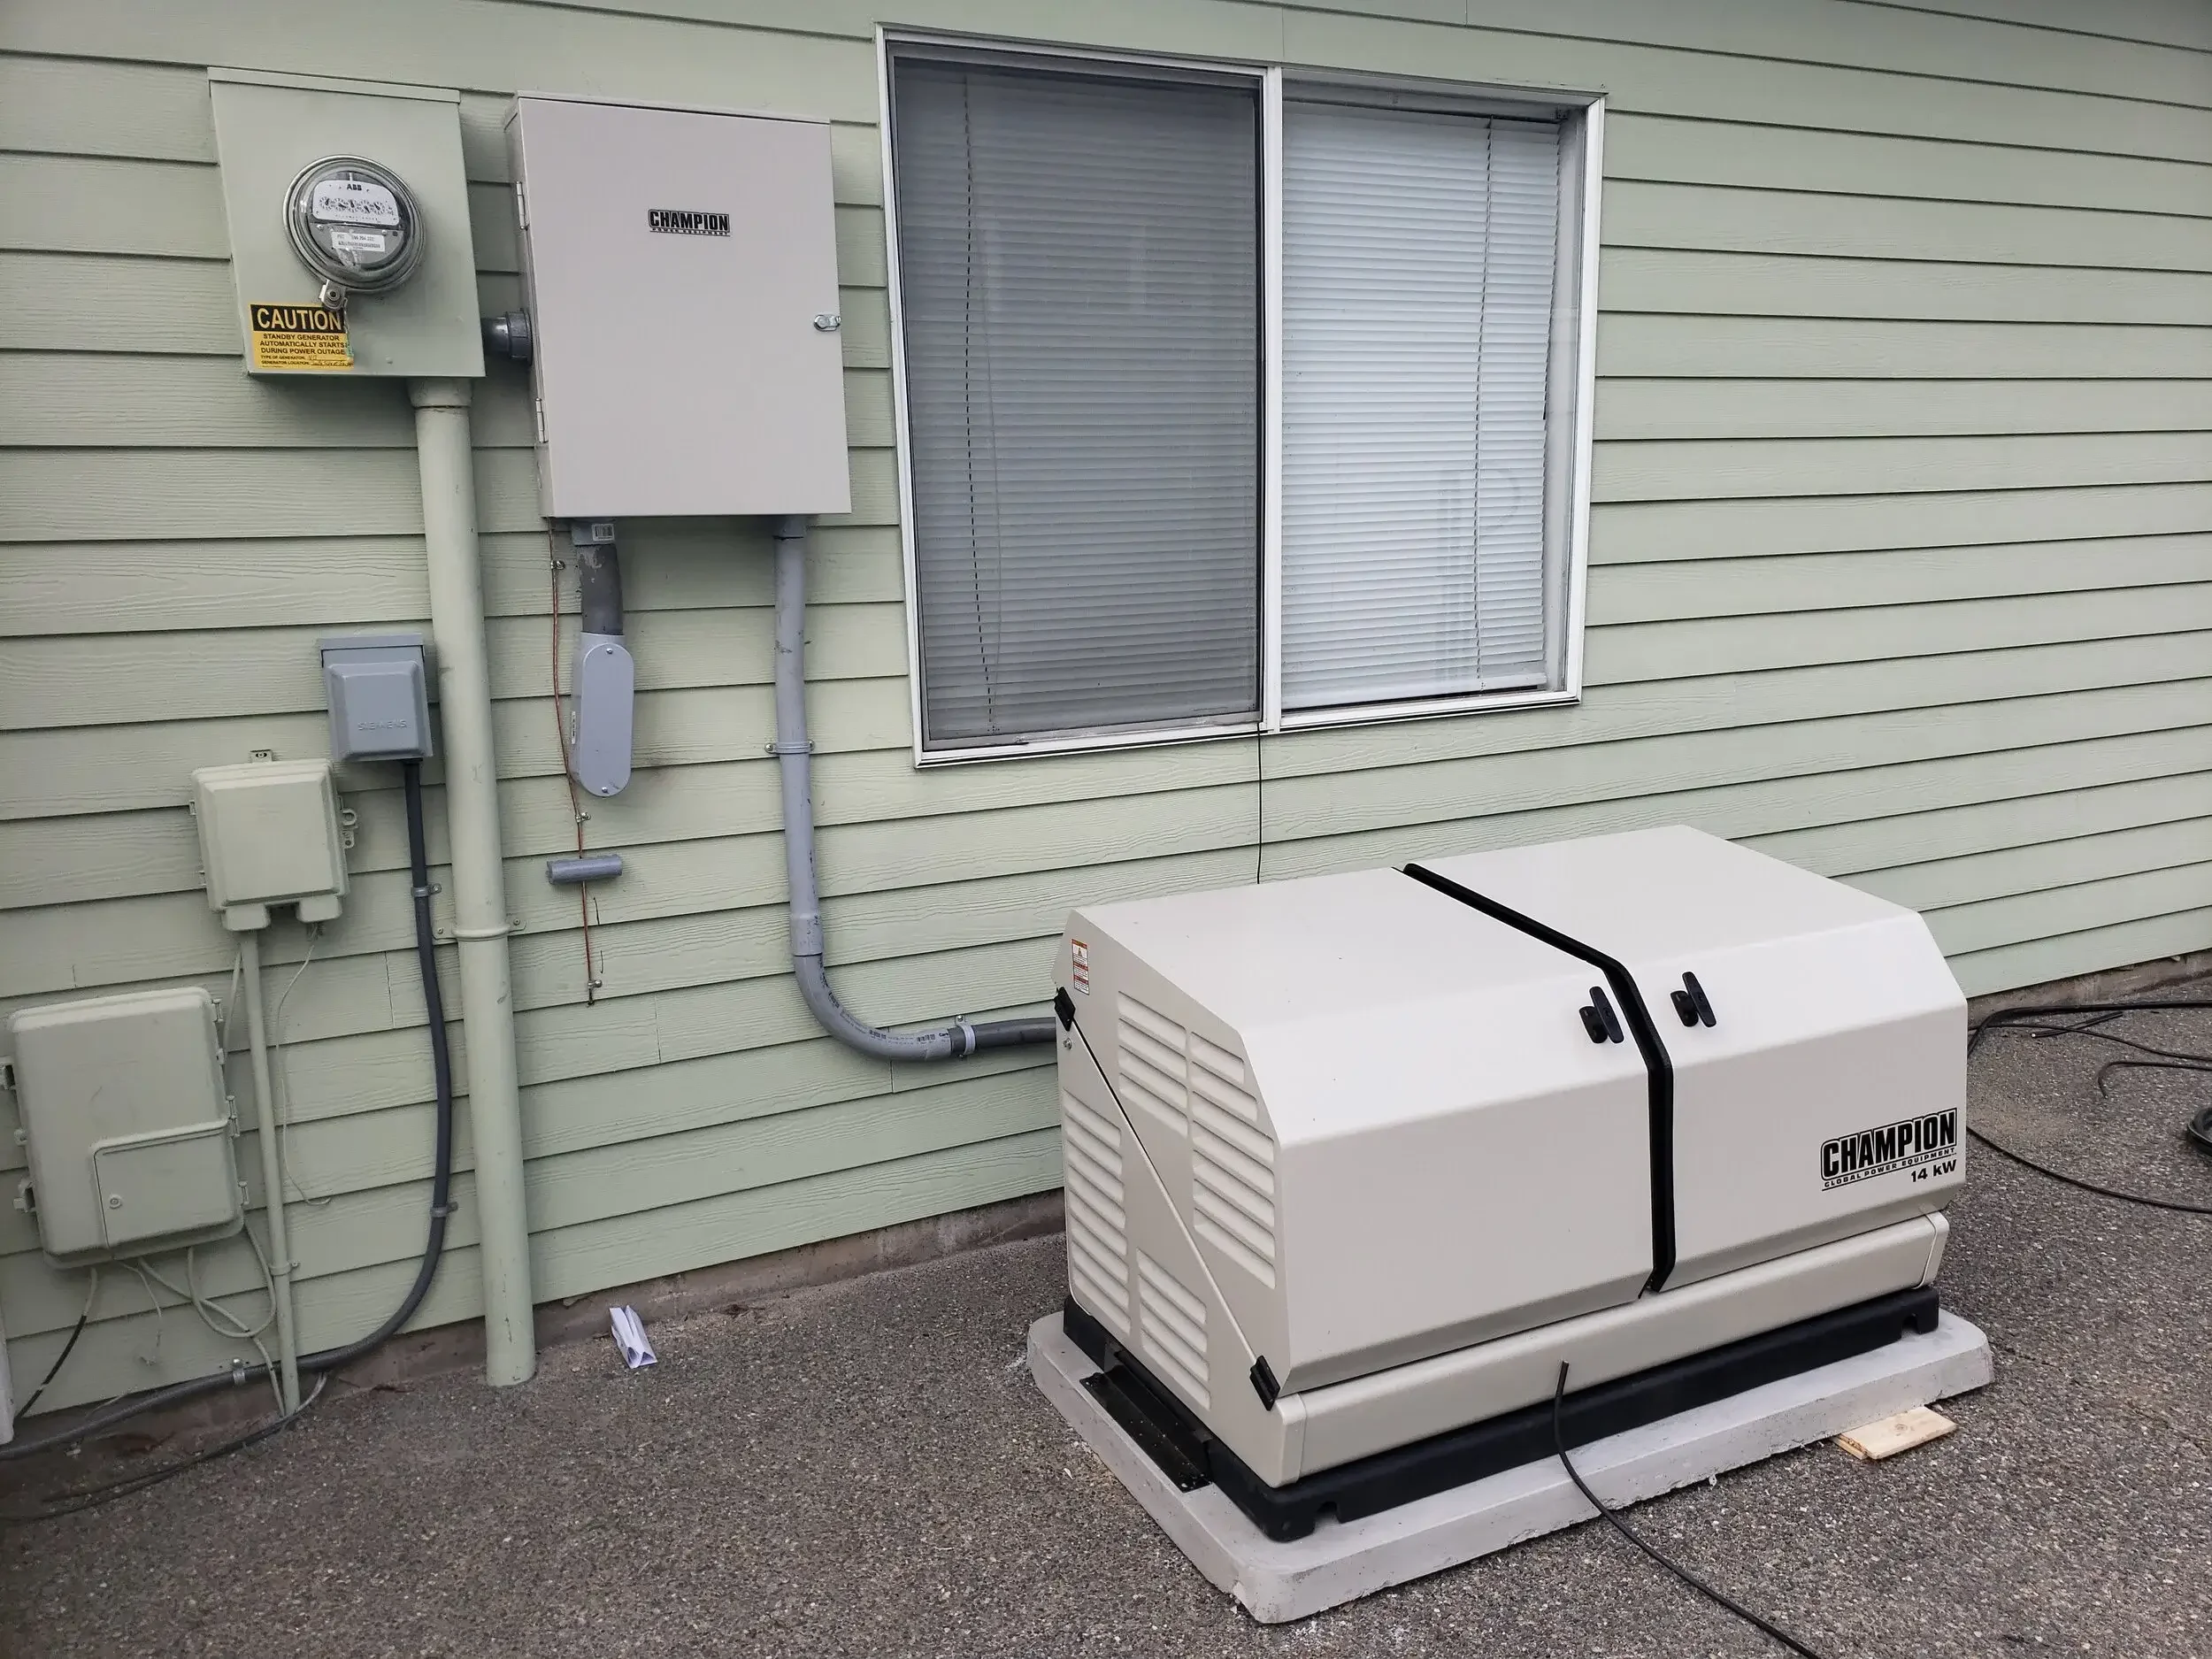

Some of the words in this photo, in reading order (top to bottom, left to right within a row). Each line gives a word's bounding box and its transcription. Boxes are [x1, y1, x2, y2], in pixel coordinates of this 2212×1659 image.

[649, 211, 728, 231] CHAMPION
[257, 308, 342, 331] CAUTION
[1823, 1110, 1955, 1178] CHAMPION
[1824, 1173, 1862, 1187] GLOBAL
[1864, 1164, 1897, 1177] POWER
[1901, 1148, 1955, 1166] EQUIPMENT
[1911, 1168, 1928, 1182] 14
[1932, 1159, 1957, 1177] kW
